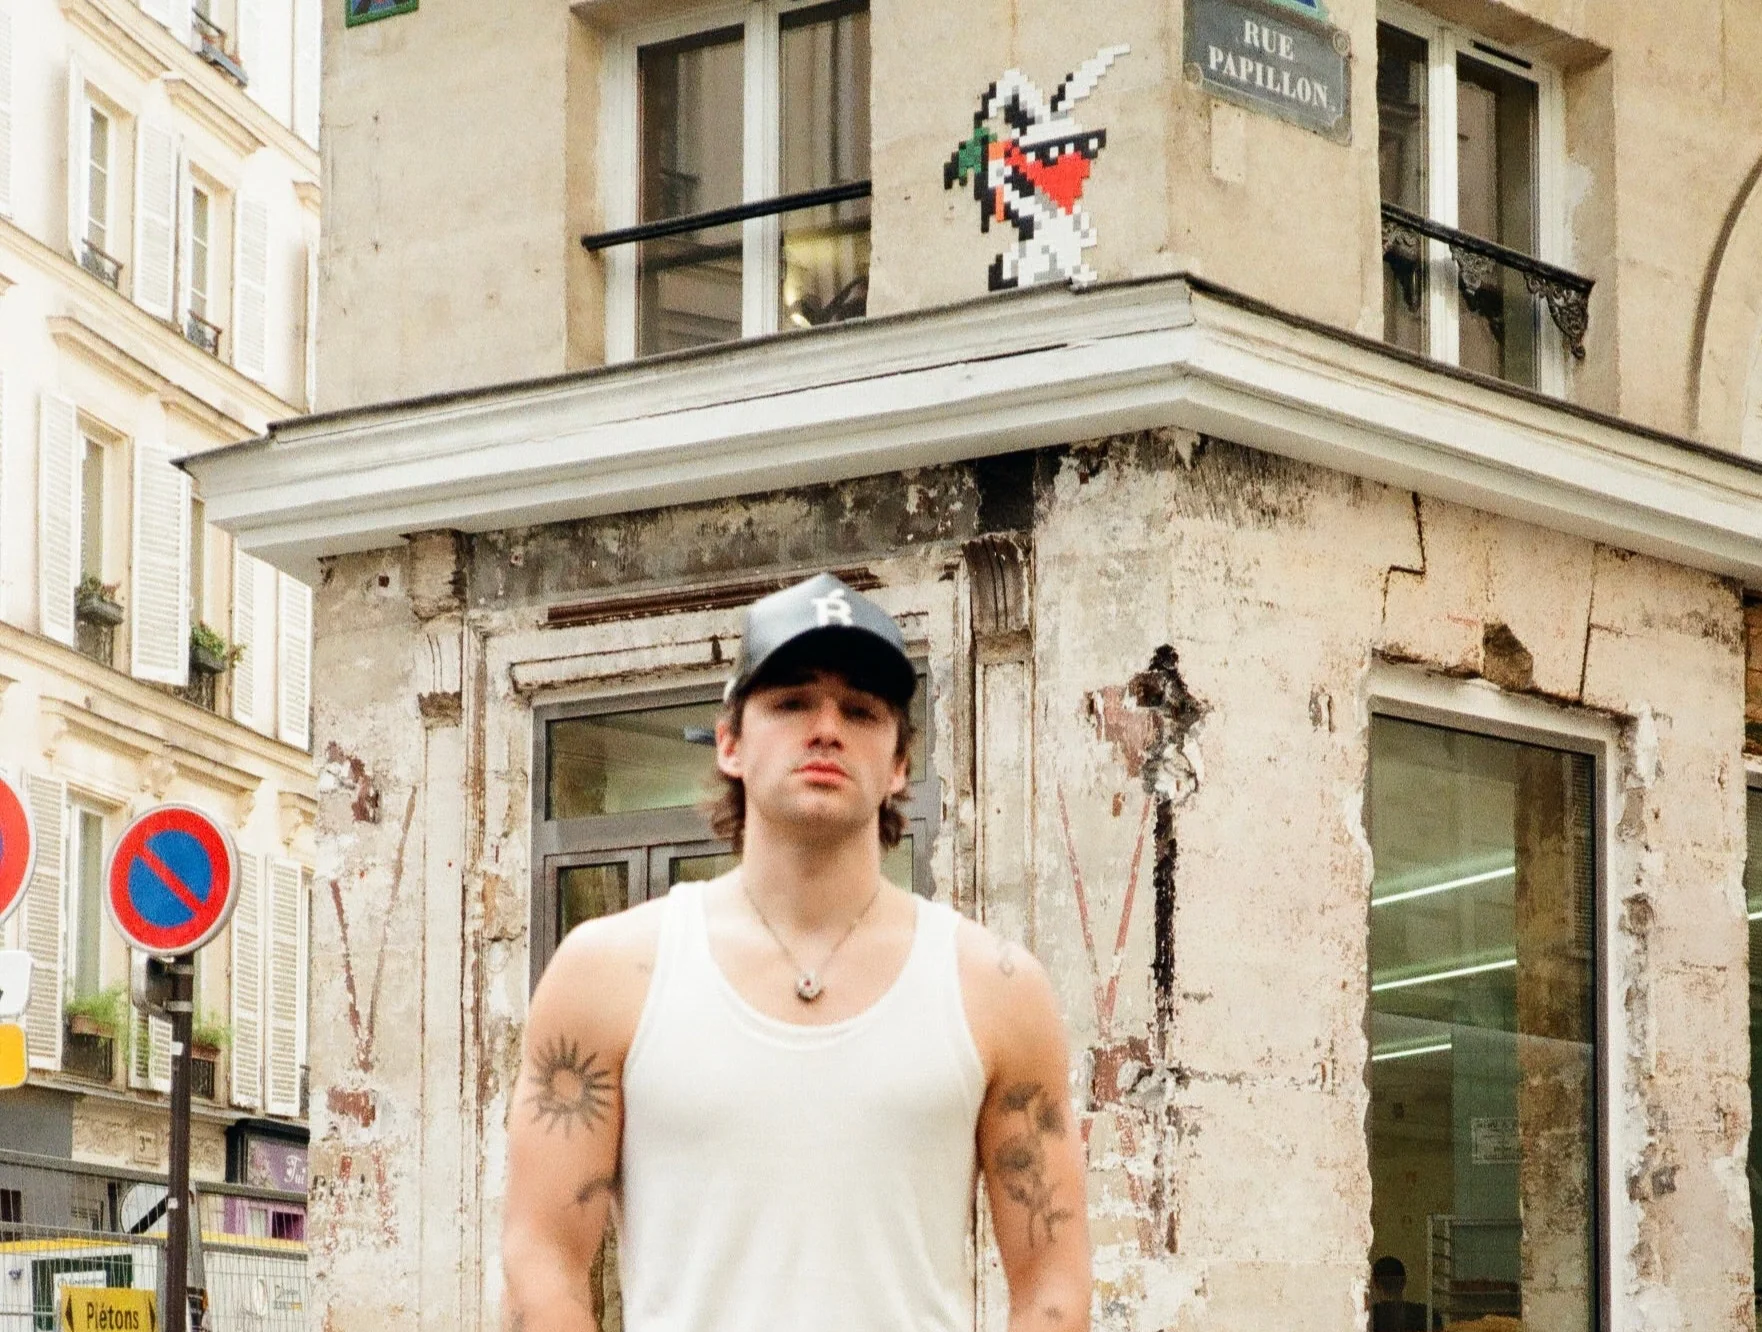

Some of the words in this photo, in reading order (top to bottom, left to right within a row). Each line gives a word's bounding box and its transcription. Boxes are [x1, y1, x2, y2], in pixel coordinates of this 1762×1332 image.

[1243, 19, 1294, 61] RUE
[1208, 45, 1328, 109] PAPILLON
[86, 1302, 139, 1330] Piétons
